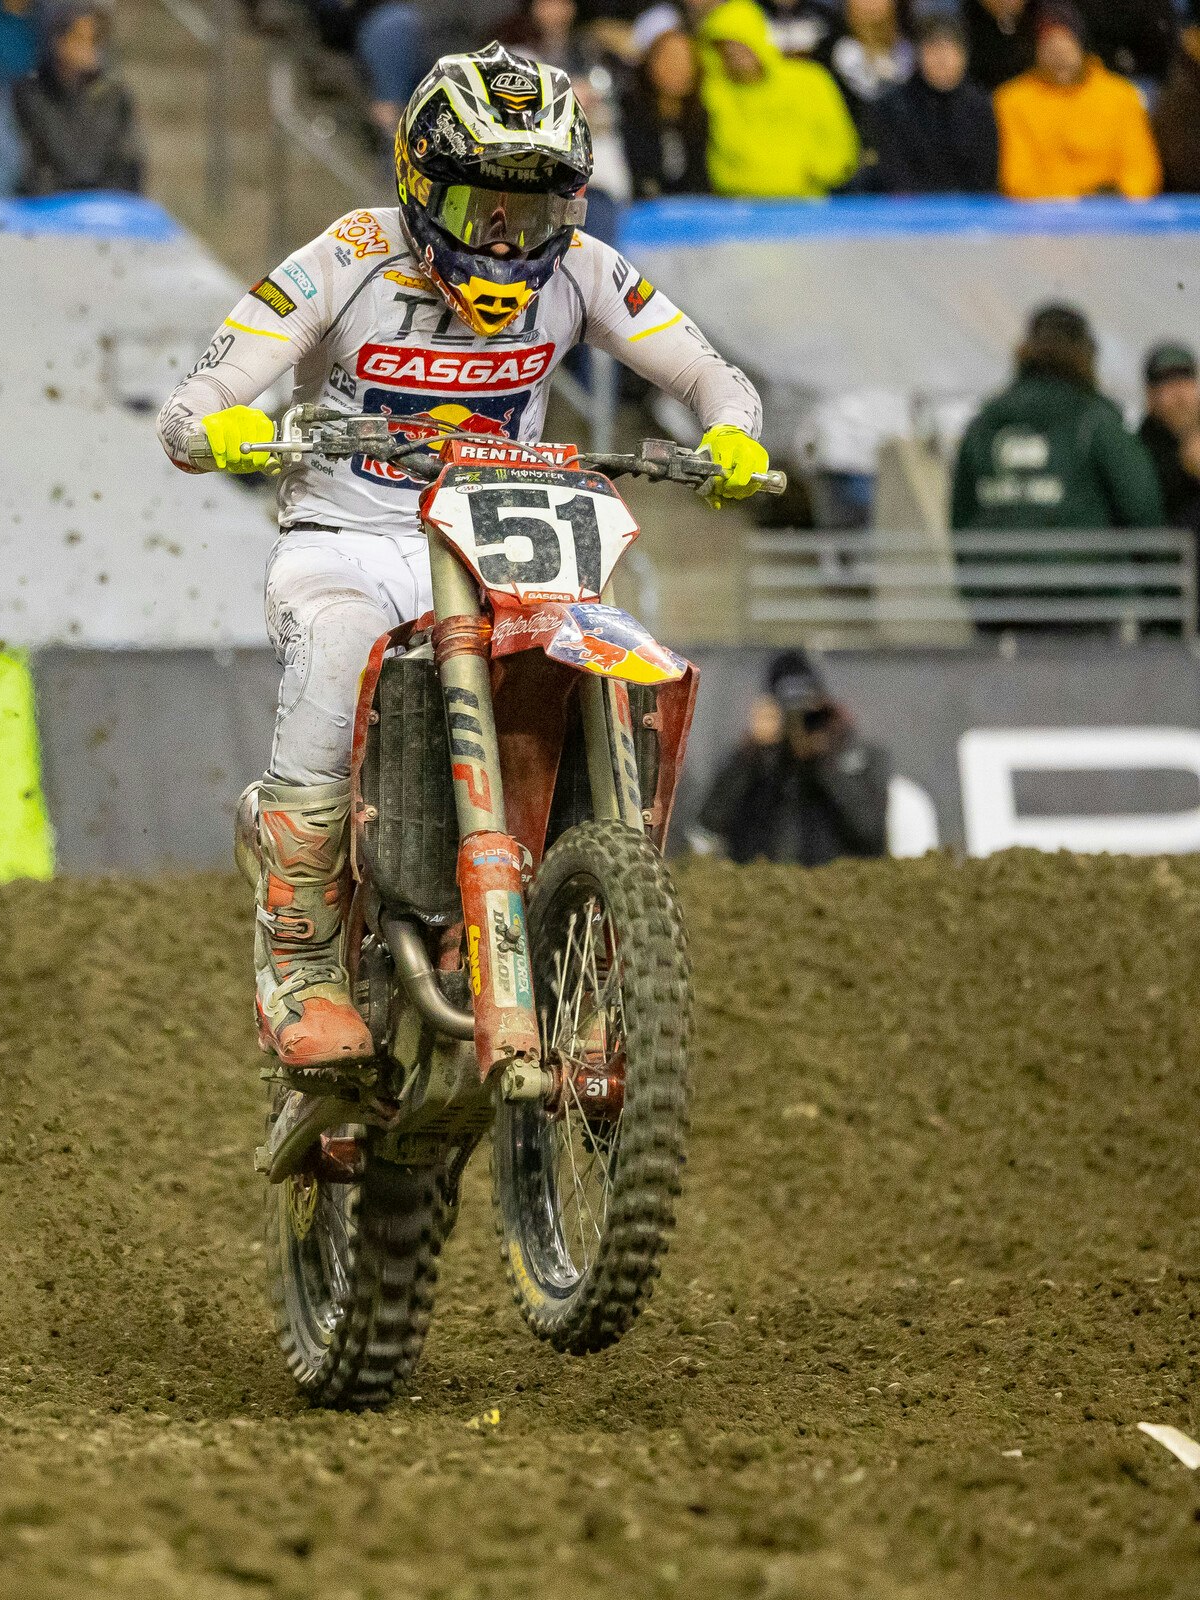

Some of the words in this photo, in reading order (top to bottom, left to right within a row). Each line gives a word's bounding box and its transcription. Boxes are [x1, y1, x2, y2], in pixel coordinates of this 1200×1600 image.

[363, 351, 547, 384] GASGAS
[460, 446, 566, 464] RENTHAL
[510, 468, 565, 480] MONSTER
[467, 488, 602, 594] 51
[527, 592, 571, 601] GASGAS
[586, 1077, 608, 1097] 51
